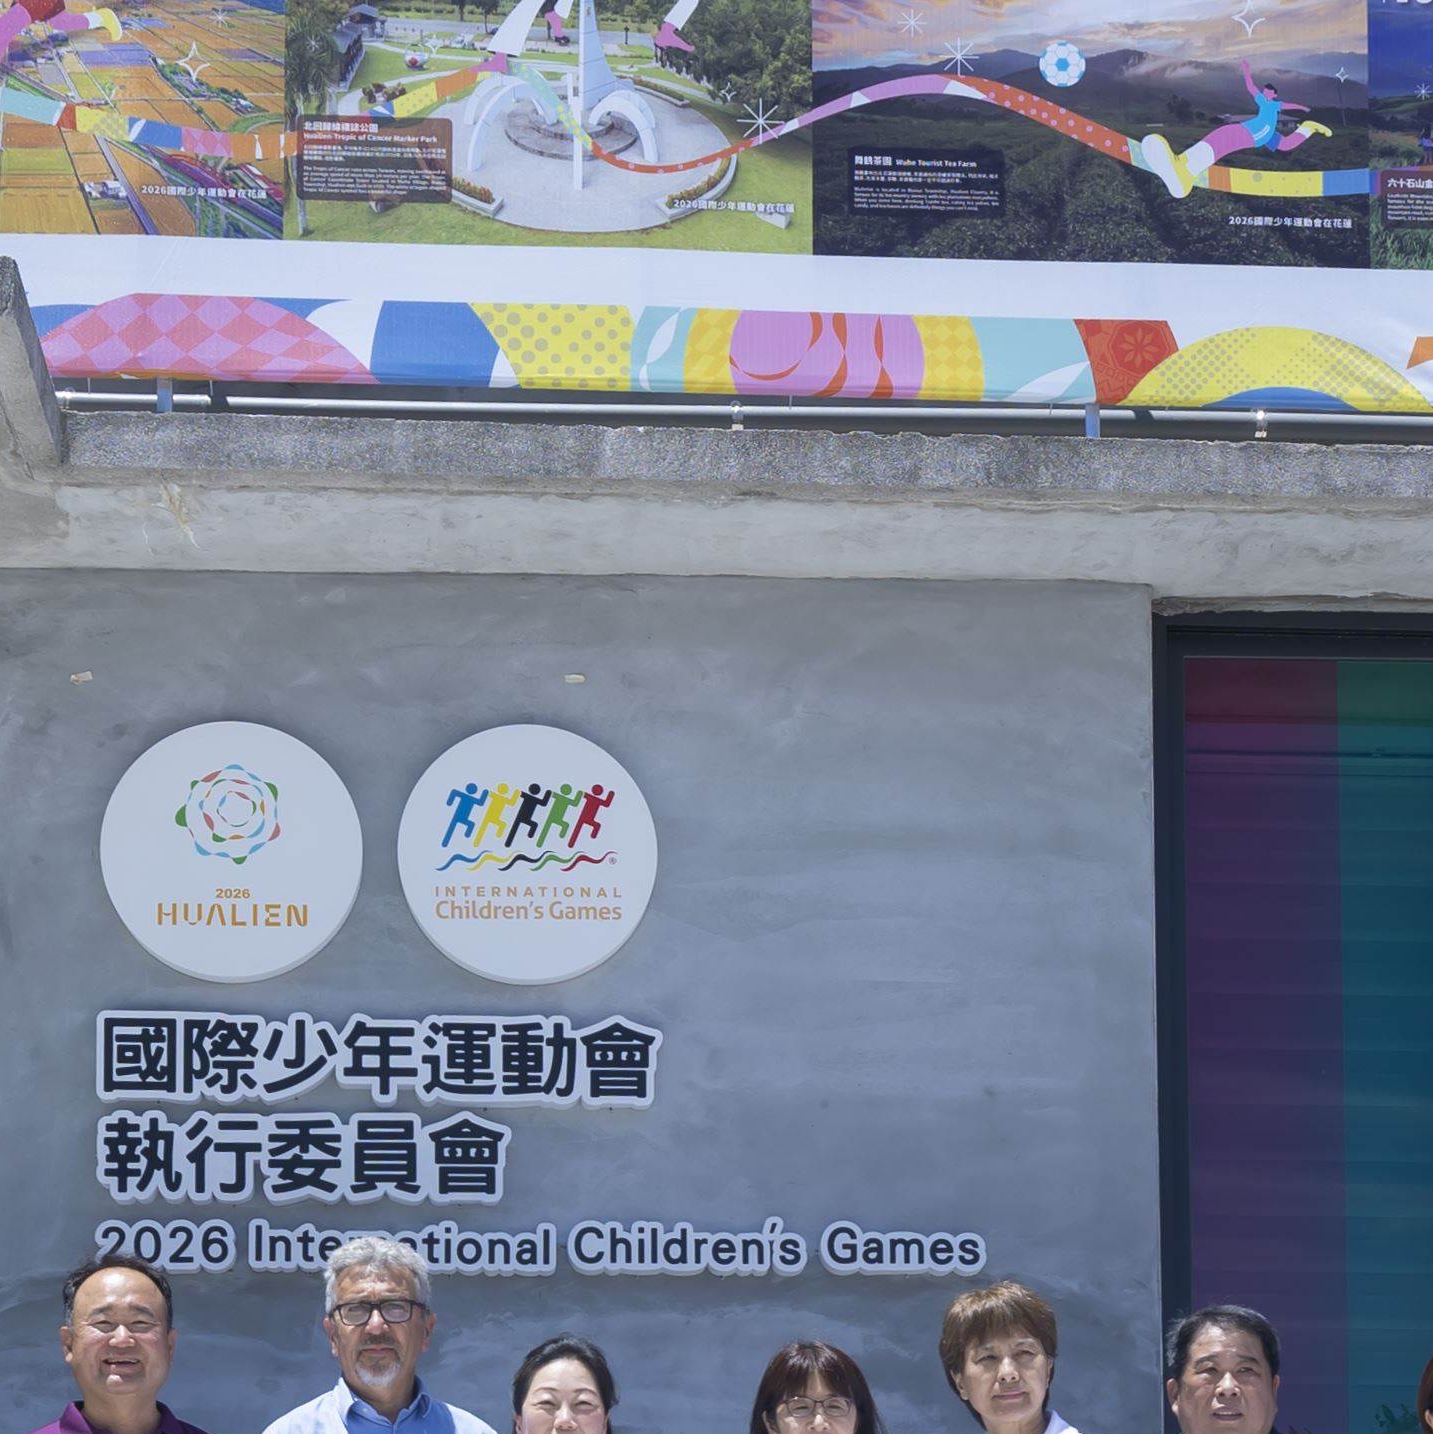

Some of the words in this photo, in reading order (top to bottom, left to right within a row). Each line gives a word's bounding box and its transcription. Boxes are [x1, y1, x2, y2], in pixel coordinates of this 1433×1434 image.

[420, 135, 438, 143] Park
[215, 888, 251, 899] 2026
[435, 886, 622, 899] INTERNATIONAL
[156, 902, 309, 927] HUALIEN
[435, 900, 544, 920] Children's
[549, 901, 622, 921] Games
[102, 1017, 657, 1099] 國際少年運動會
[102, 1115, 506, 1196] 執行委員會
[101, 1225, 229, 1264] 2026
[255, 1225, 551, 1265] Intetional
[573, 1222, 801, 1266] Children's
[827, 1225, 981, 1265] Games
